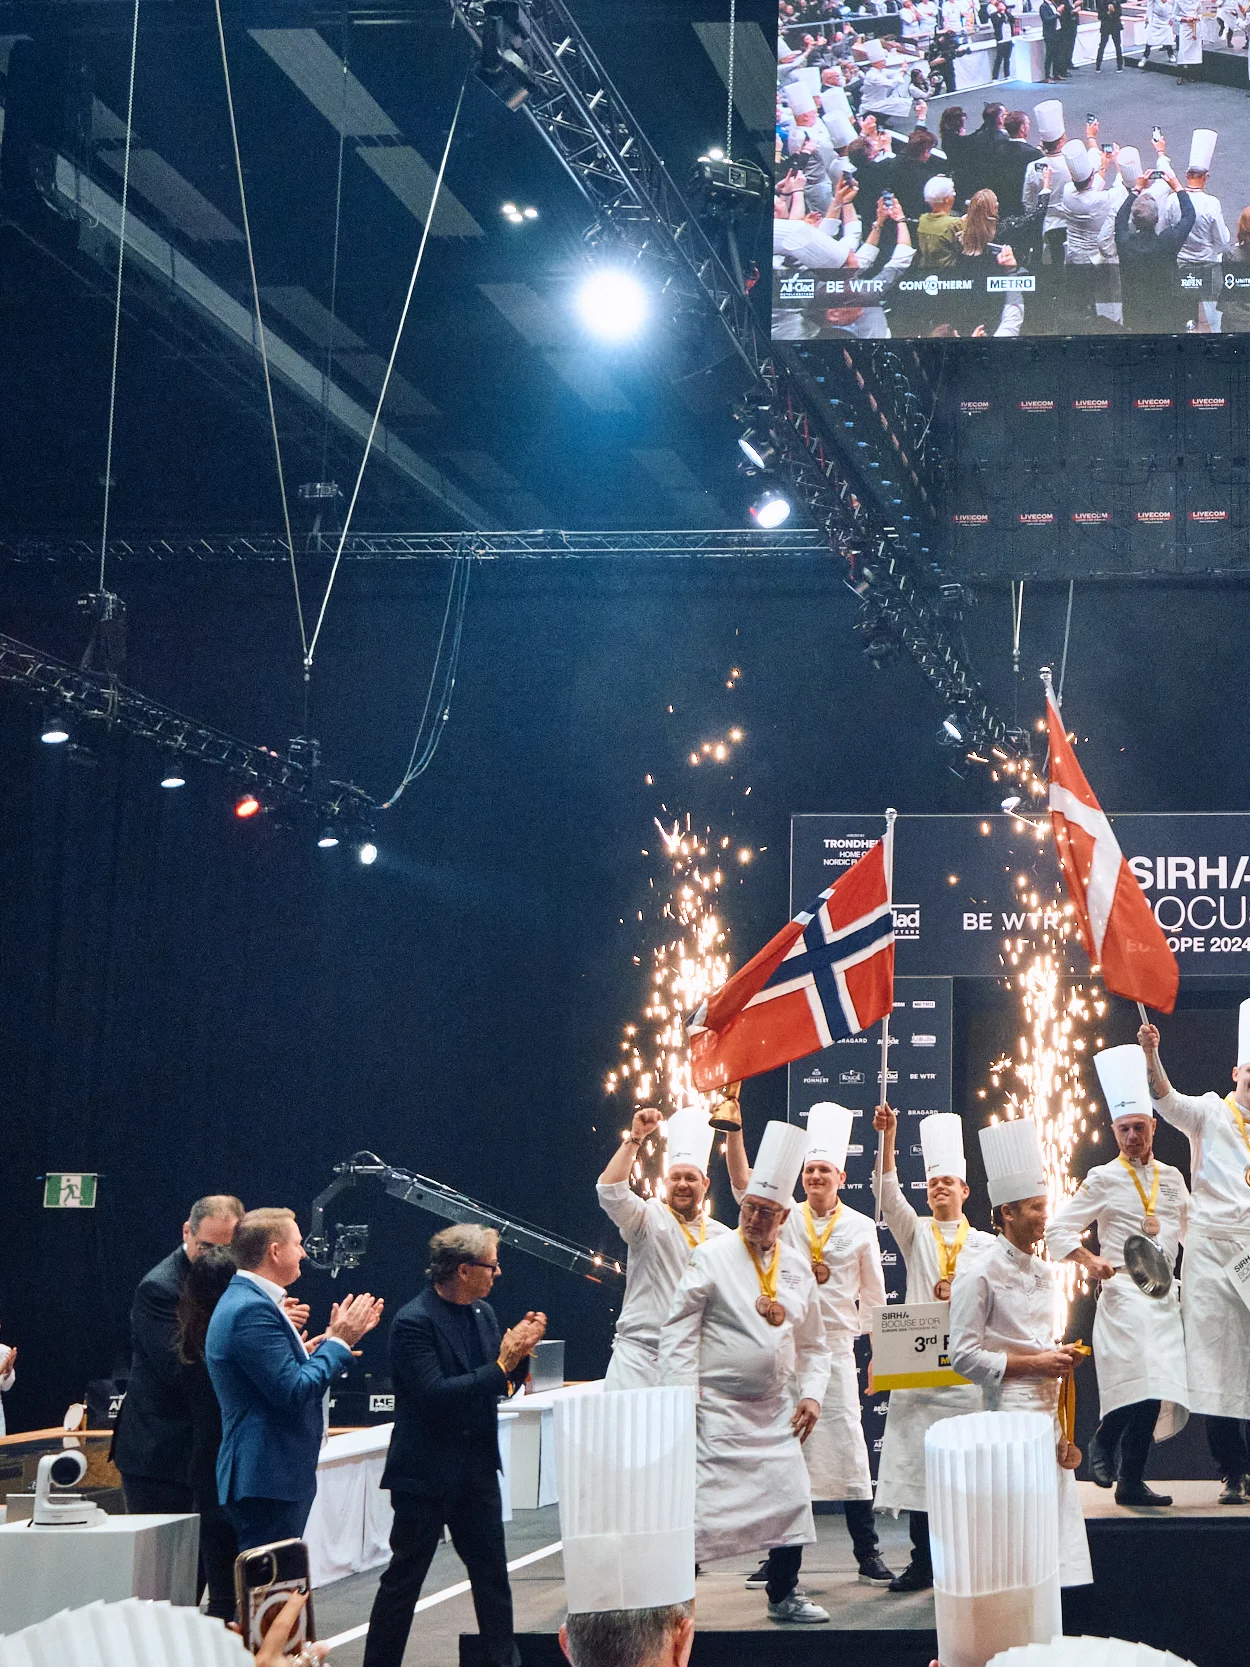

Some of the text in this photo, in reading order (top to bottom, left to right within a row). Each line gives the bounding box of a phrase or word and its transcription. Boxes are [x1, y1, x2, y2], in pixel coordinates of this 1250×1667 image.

[826, 279, 884, 293] BE WTR
[900, 280, 972, 291] CONVOTHERM
[989, 278, 1033, 289] METRO
[823, 839, 879, 849] TRONDHE
[839, 850, 861, 858] HOME
[823, 858, 850, 866] NORDIC
[962, 912, 1059, 931] BE WTR
[881, 1319, 917, 1329] BOCUSE
[914, 1335, 938, 1352] 3rd
